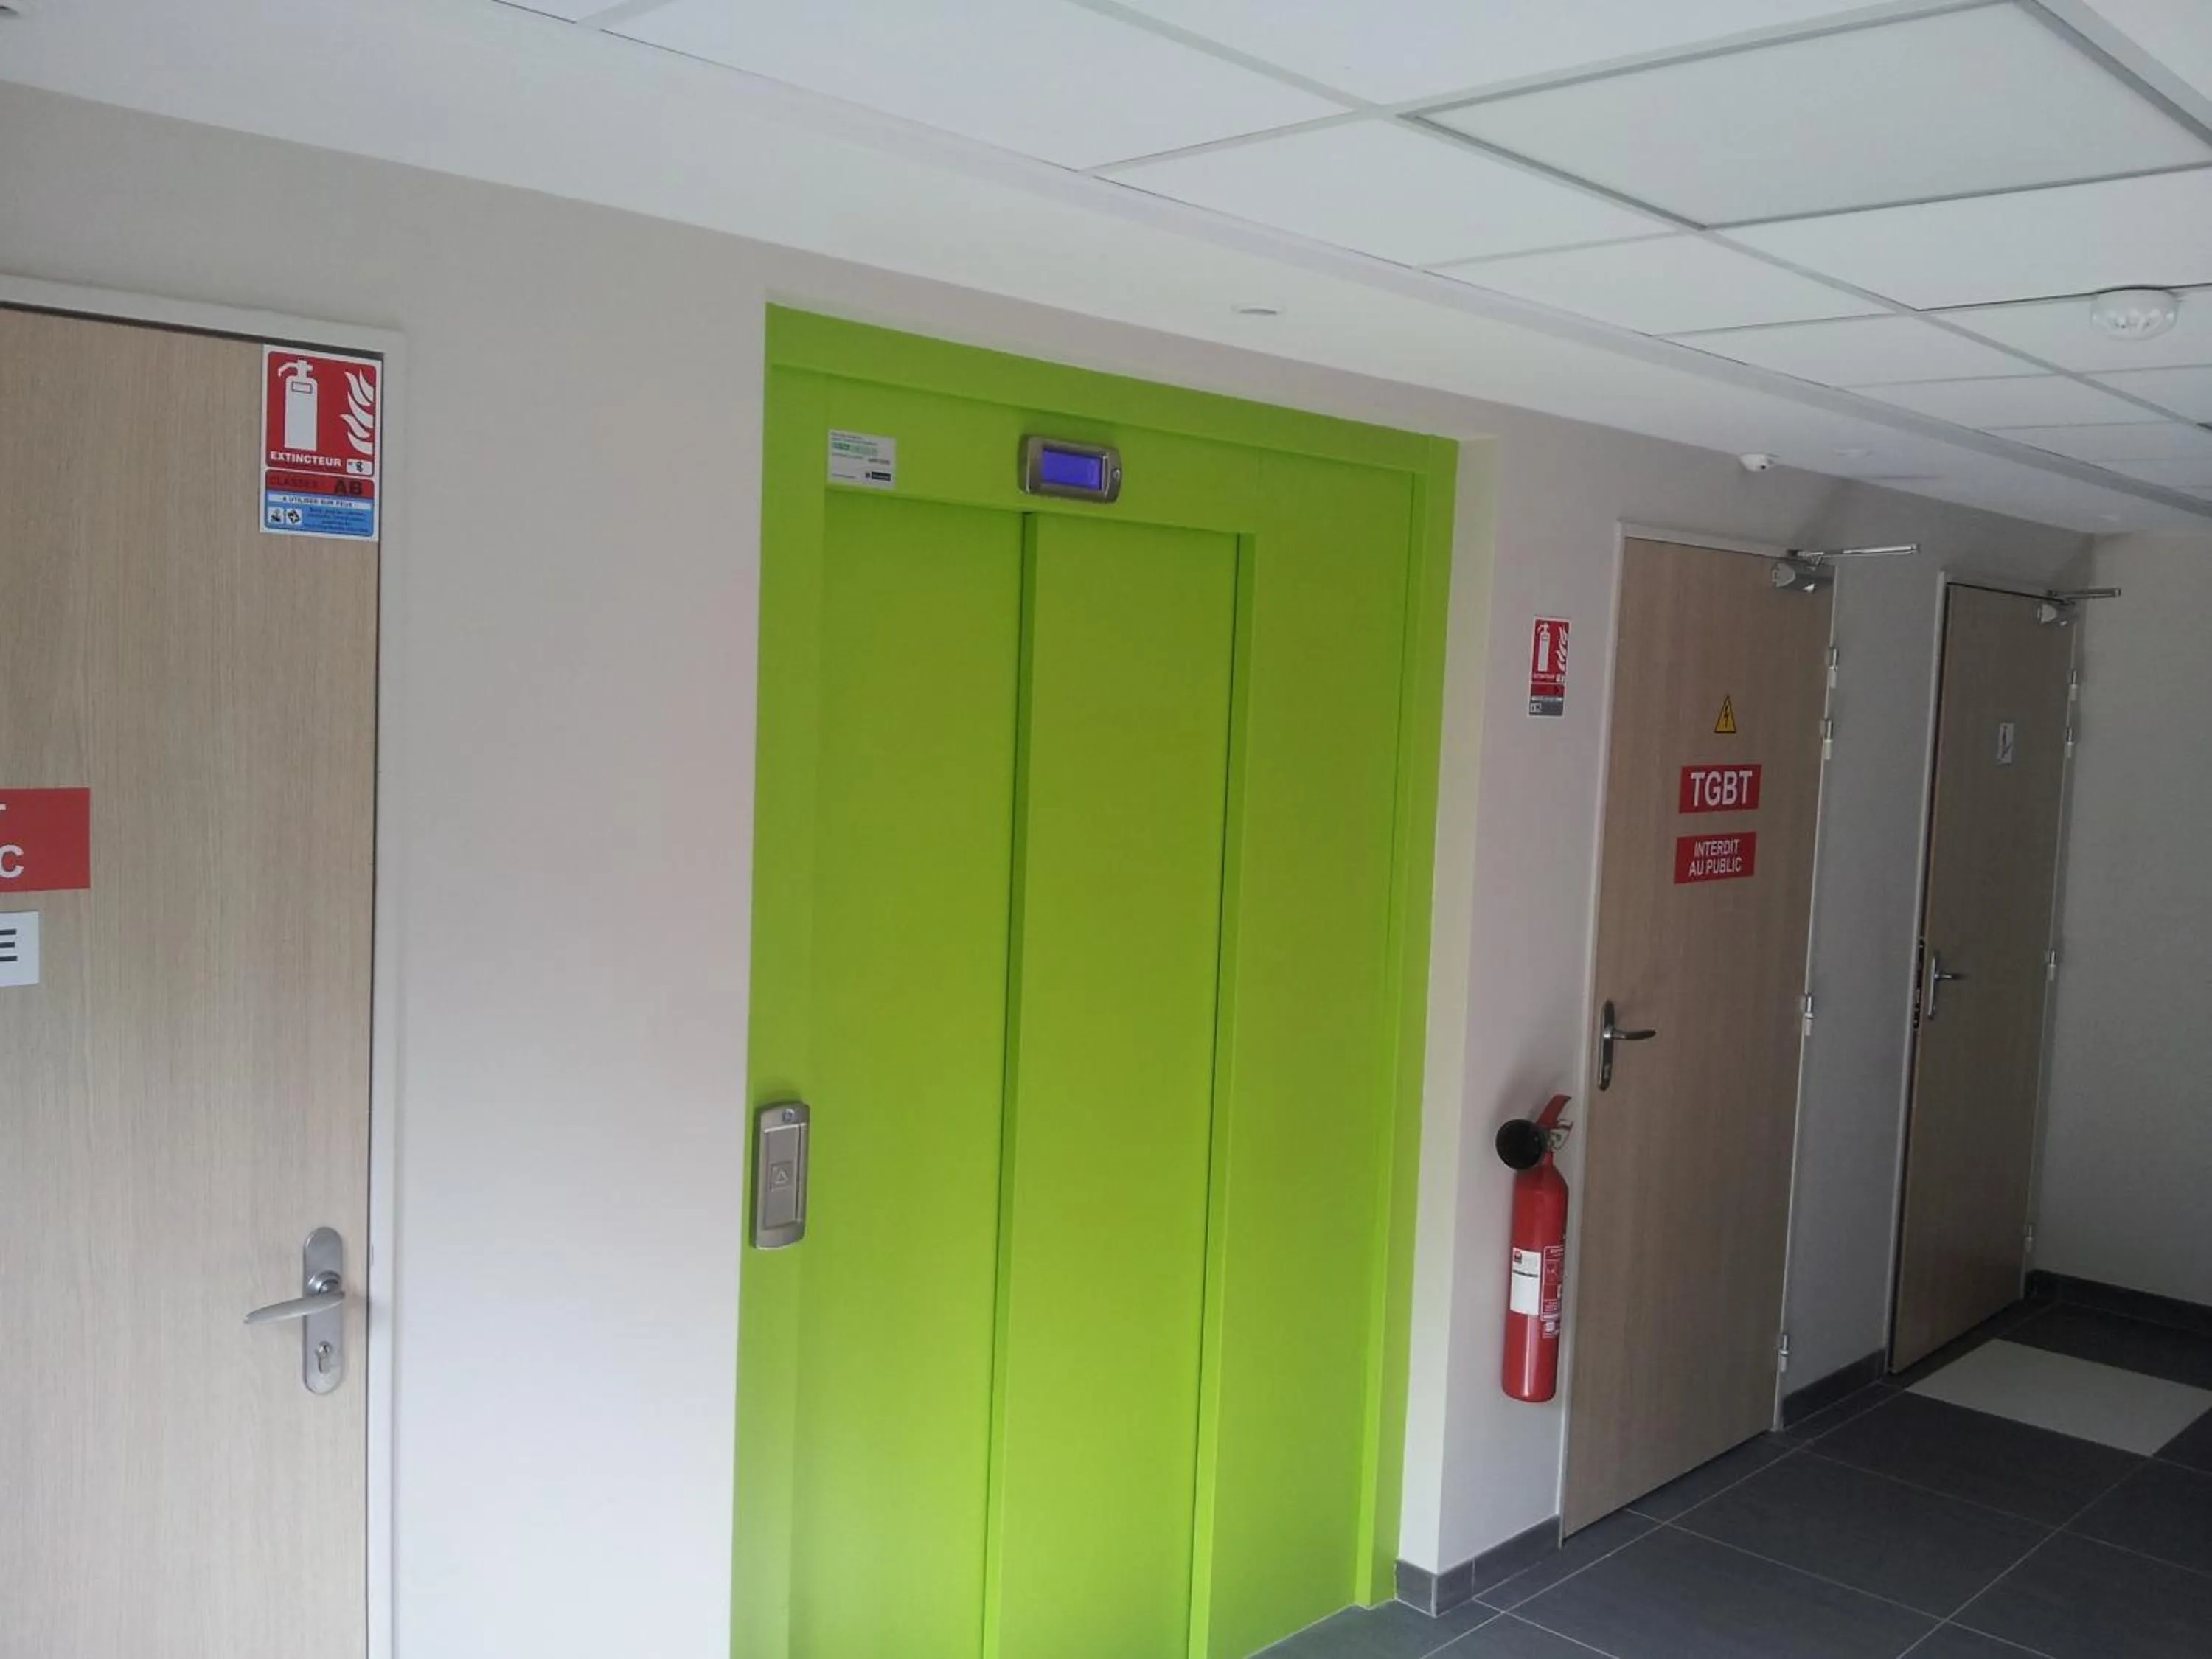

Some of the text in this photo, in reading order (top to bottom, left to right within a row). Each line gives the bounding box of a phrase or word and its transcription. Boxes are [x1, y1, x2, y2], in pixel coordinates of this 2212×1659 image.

[271, 451, 341, 467] EXTINCTEUR
[335, 480, 362, 495] AB
[1691, 771, 1753, 807] TGBT
[1694, 839, 1740, 857] INTERDIT
[1689, 857, 1742, 877] AU PUBLIC
